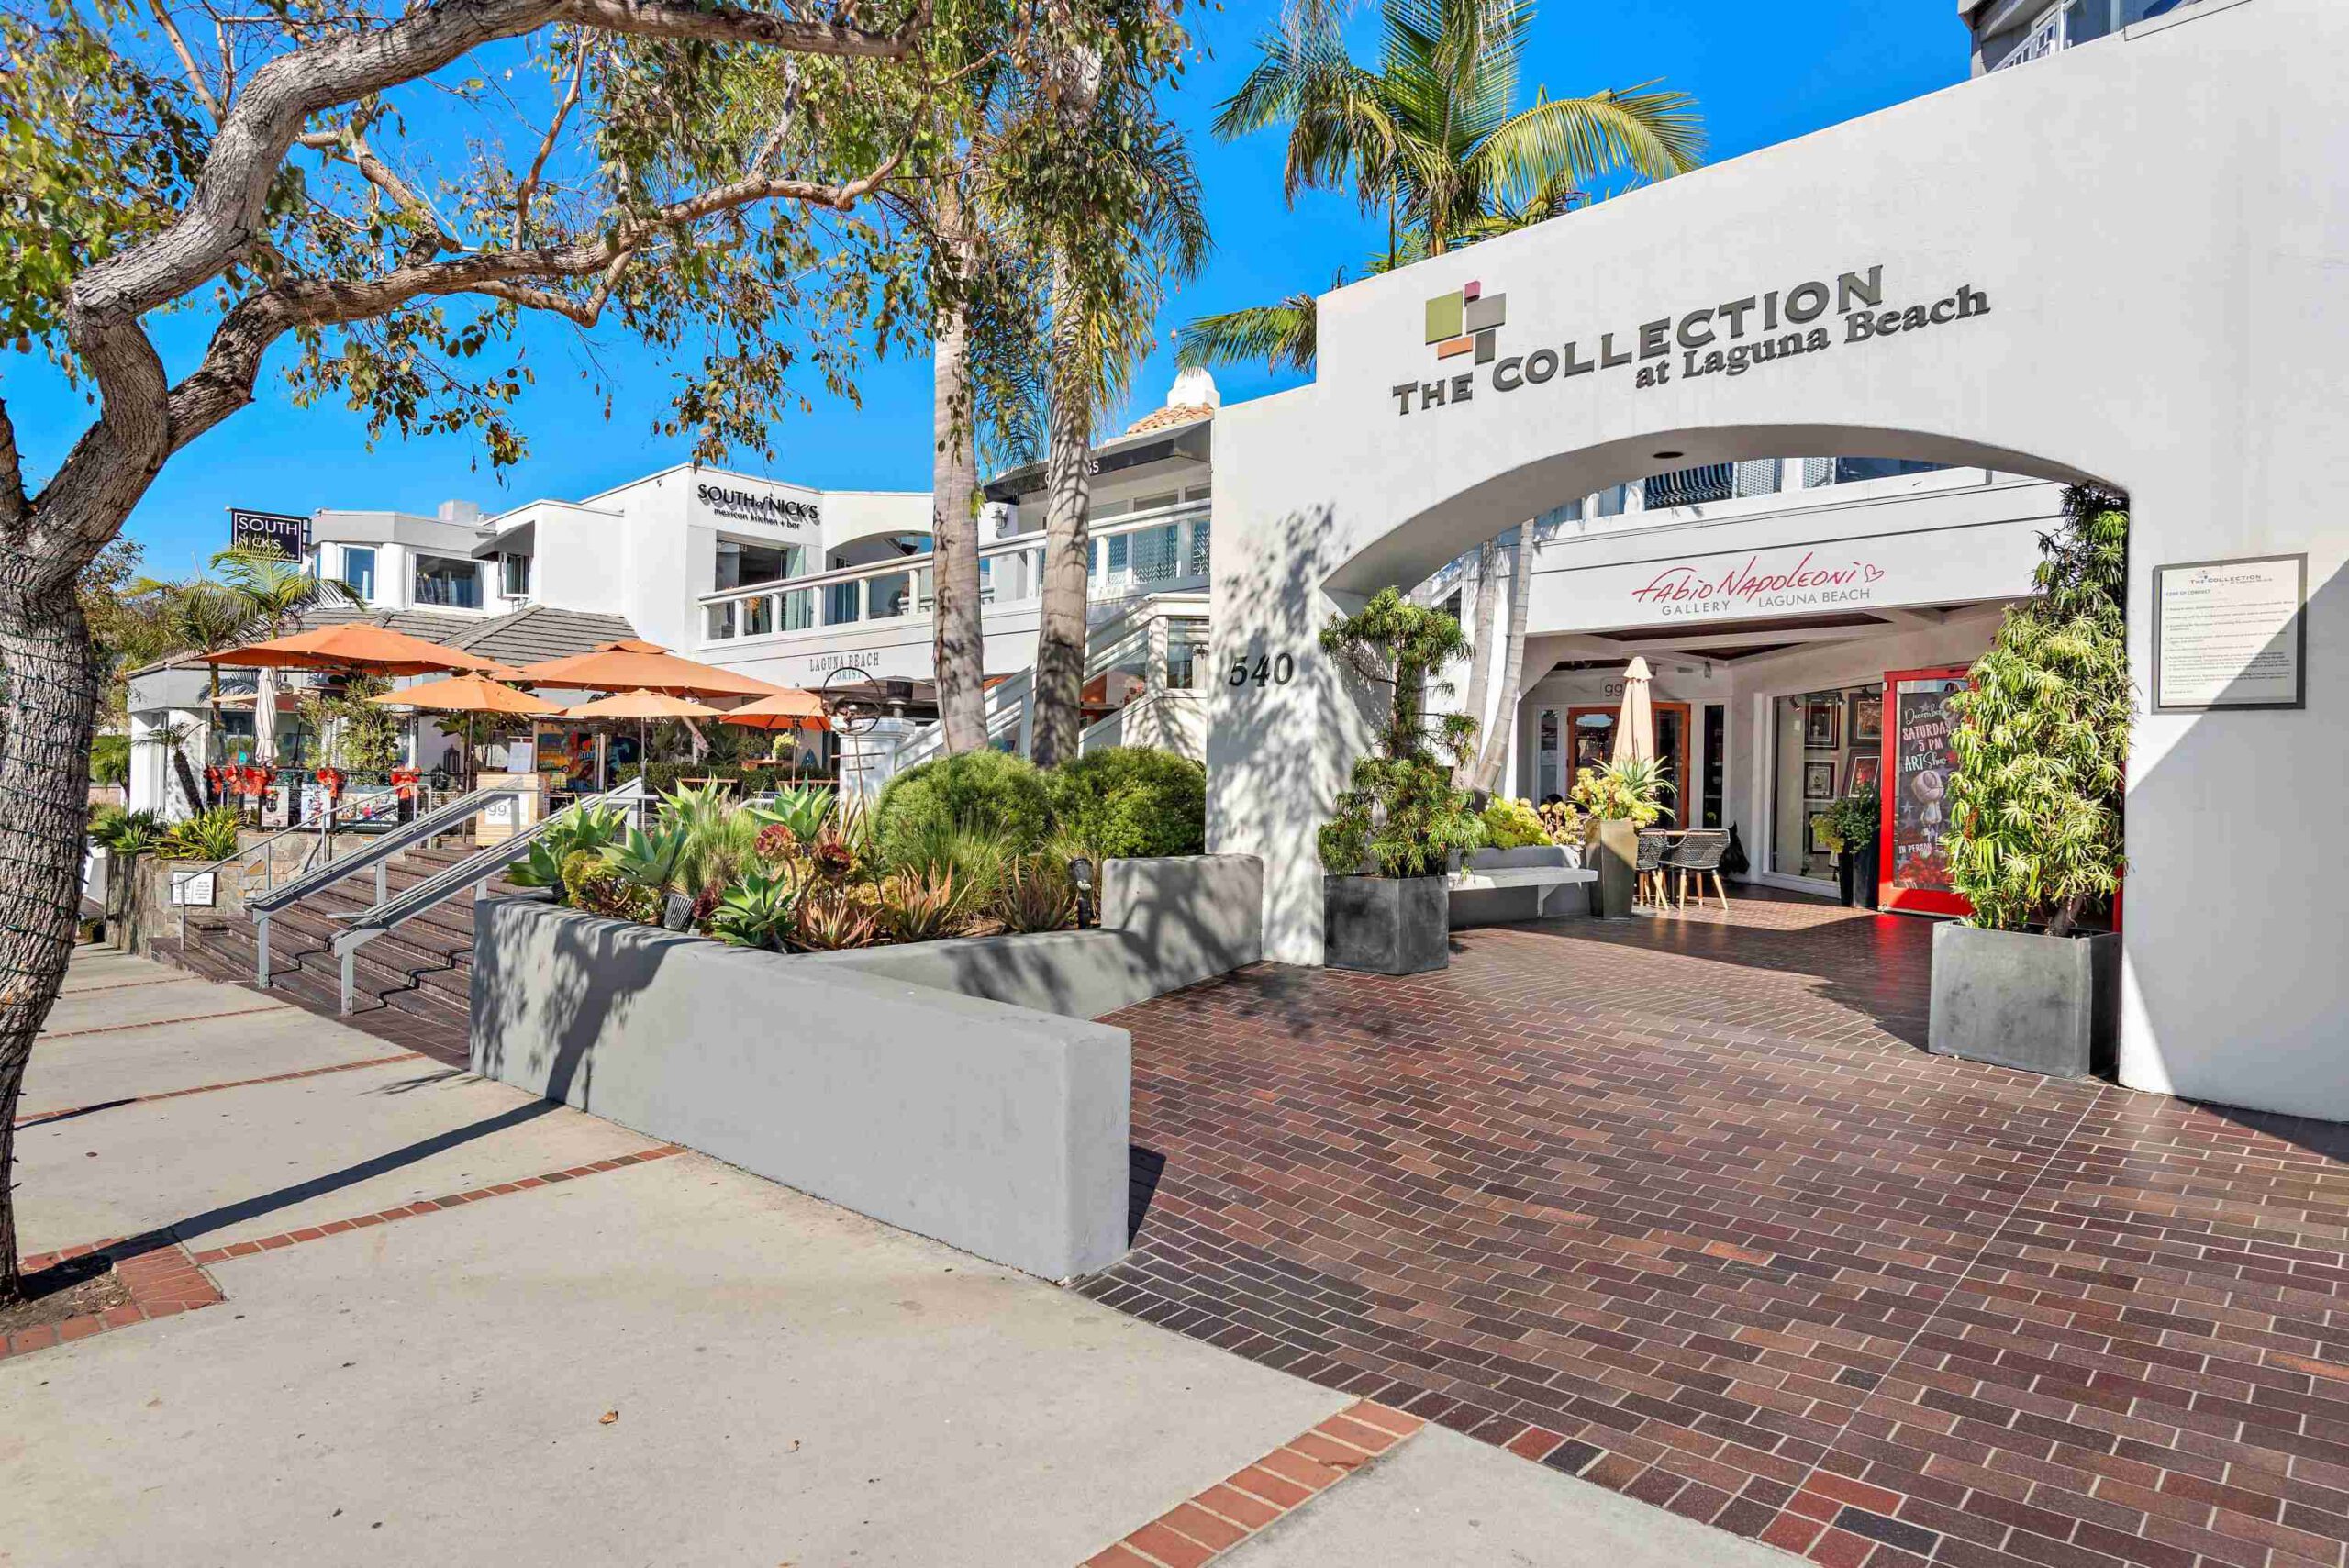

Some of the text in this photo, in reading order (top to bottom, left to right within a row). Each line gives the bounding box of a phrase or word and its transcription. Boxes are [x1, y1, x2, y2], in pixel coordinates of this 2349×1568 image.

[1392, 264, 1884, 416] THE COLLECTION
[1635, 284, 1991, 390] at Laguna Beach
[697, 484, 818, 519] SOUTH of NICK'S
[239, 517, 297, 536] SOUTH
[714, 508, 749, 521] mexican
[751, 513, 778, 526] kitchen
[786, 519, 800, 530] bar
[2208, 574, 2262, 584] COLLECTION
[1662, 588, 1870, 616] GALLERY LAGUNA BEACH
[809, 652, 879, 672] LAGUNA BEACH
[1229, 652, 1294, 687] 540
[1902, 720, 1951, 740] SATURDAY
[1918, 737, 1943, 751] 5 PM
[1905, 753, 1923, 772] ART
